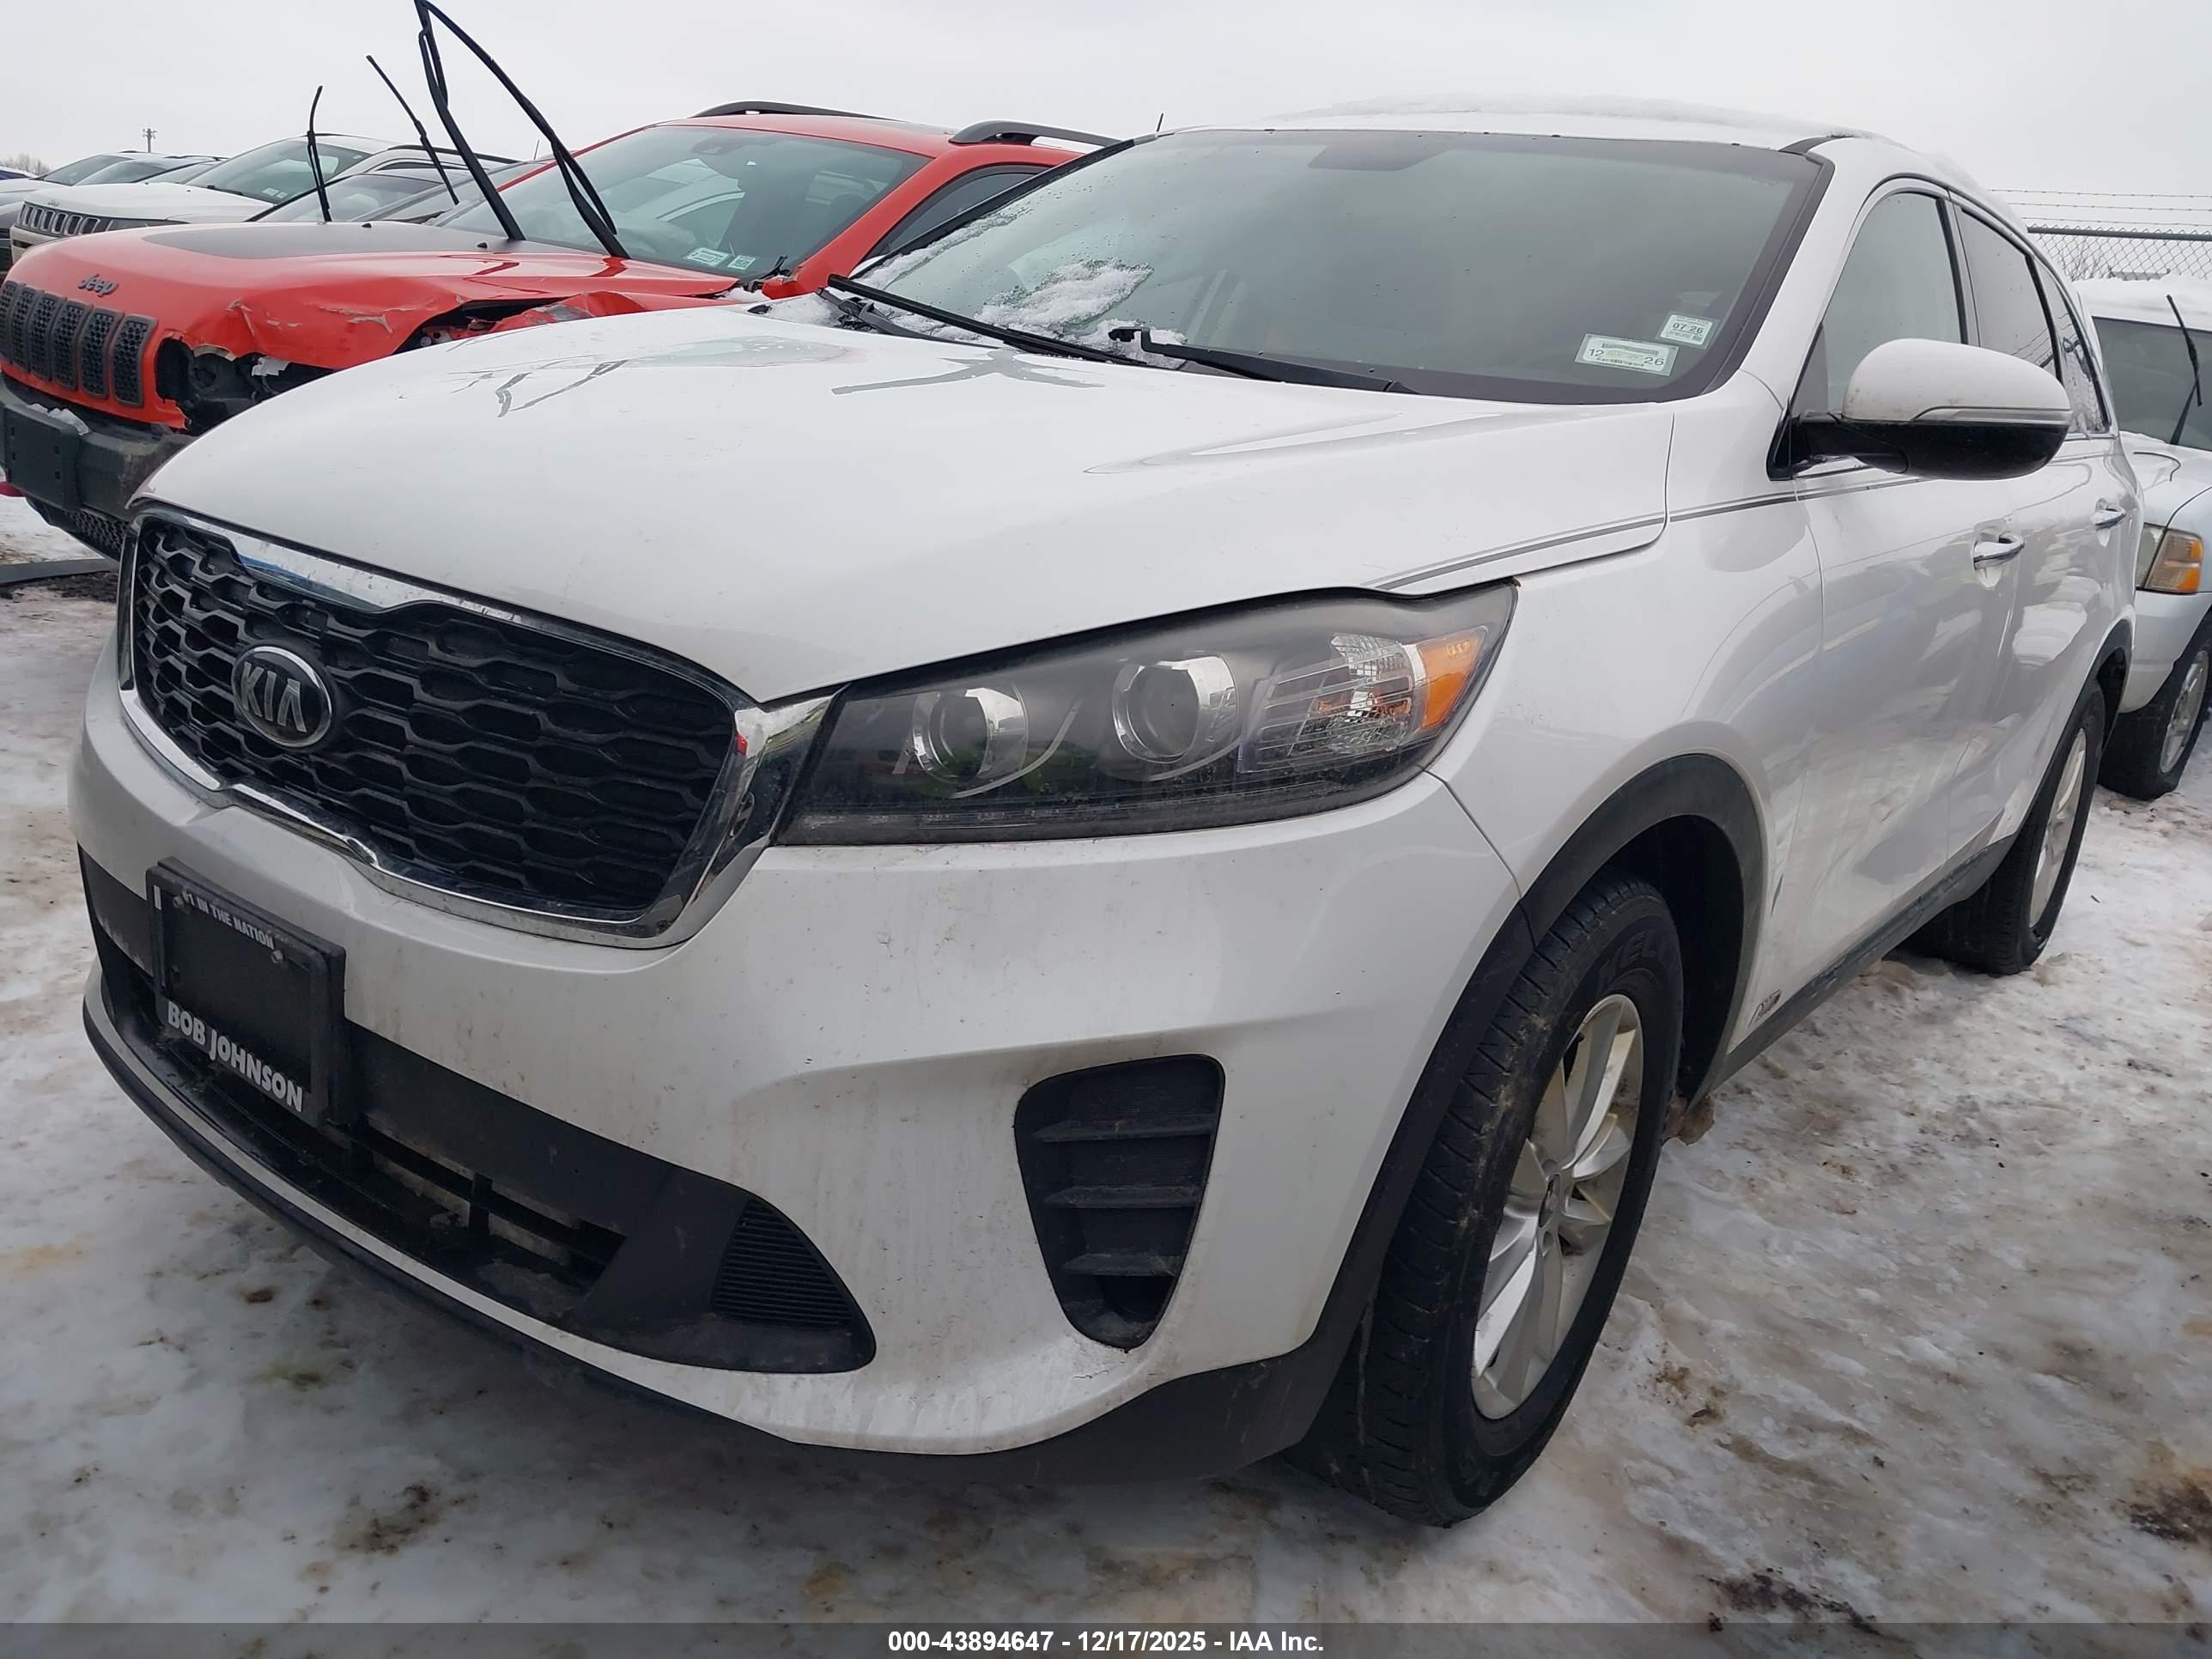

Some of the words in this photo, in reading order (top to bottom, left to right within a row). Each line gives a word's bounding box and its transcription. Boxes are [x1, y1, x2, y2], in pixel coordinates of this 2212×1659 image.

[78, 274, 118, 298] Jeep
[1689, 325, 1704, 334] 26
[1589, 348, 1604, 358] 12
[1644, 356, 1664, 367] 26
[240, 661, 307, 732] KIA
[197, 896, 210, 914] IN
[210, 904, 233, 927] THE
[233, 916, 275, 950] NATION
[167, 1001, 206, 1046] BOB
[209, 1029, 303, 1113] JOHNSON
